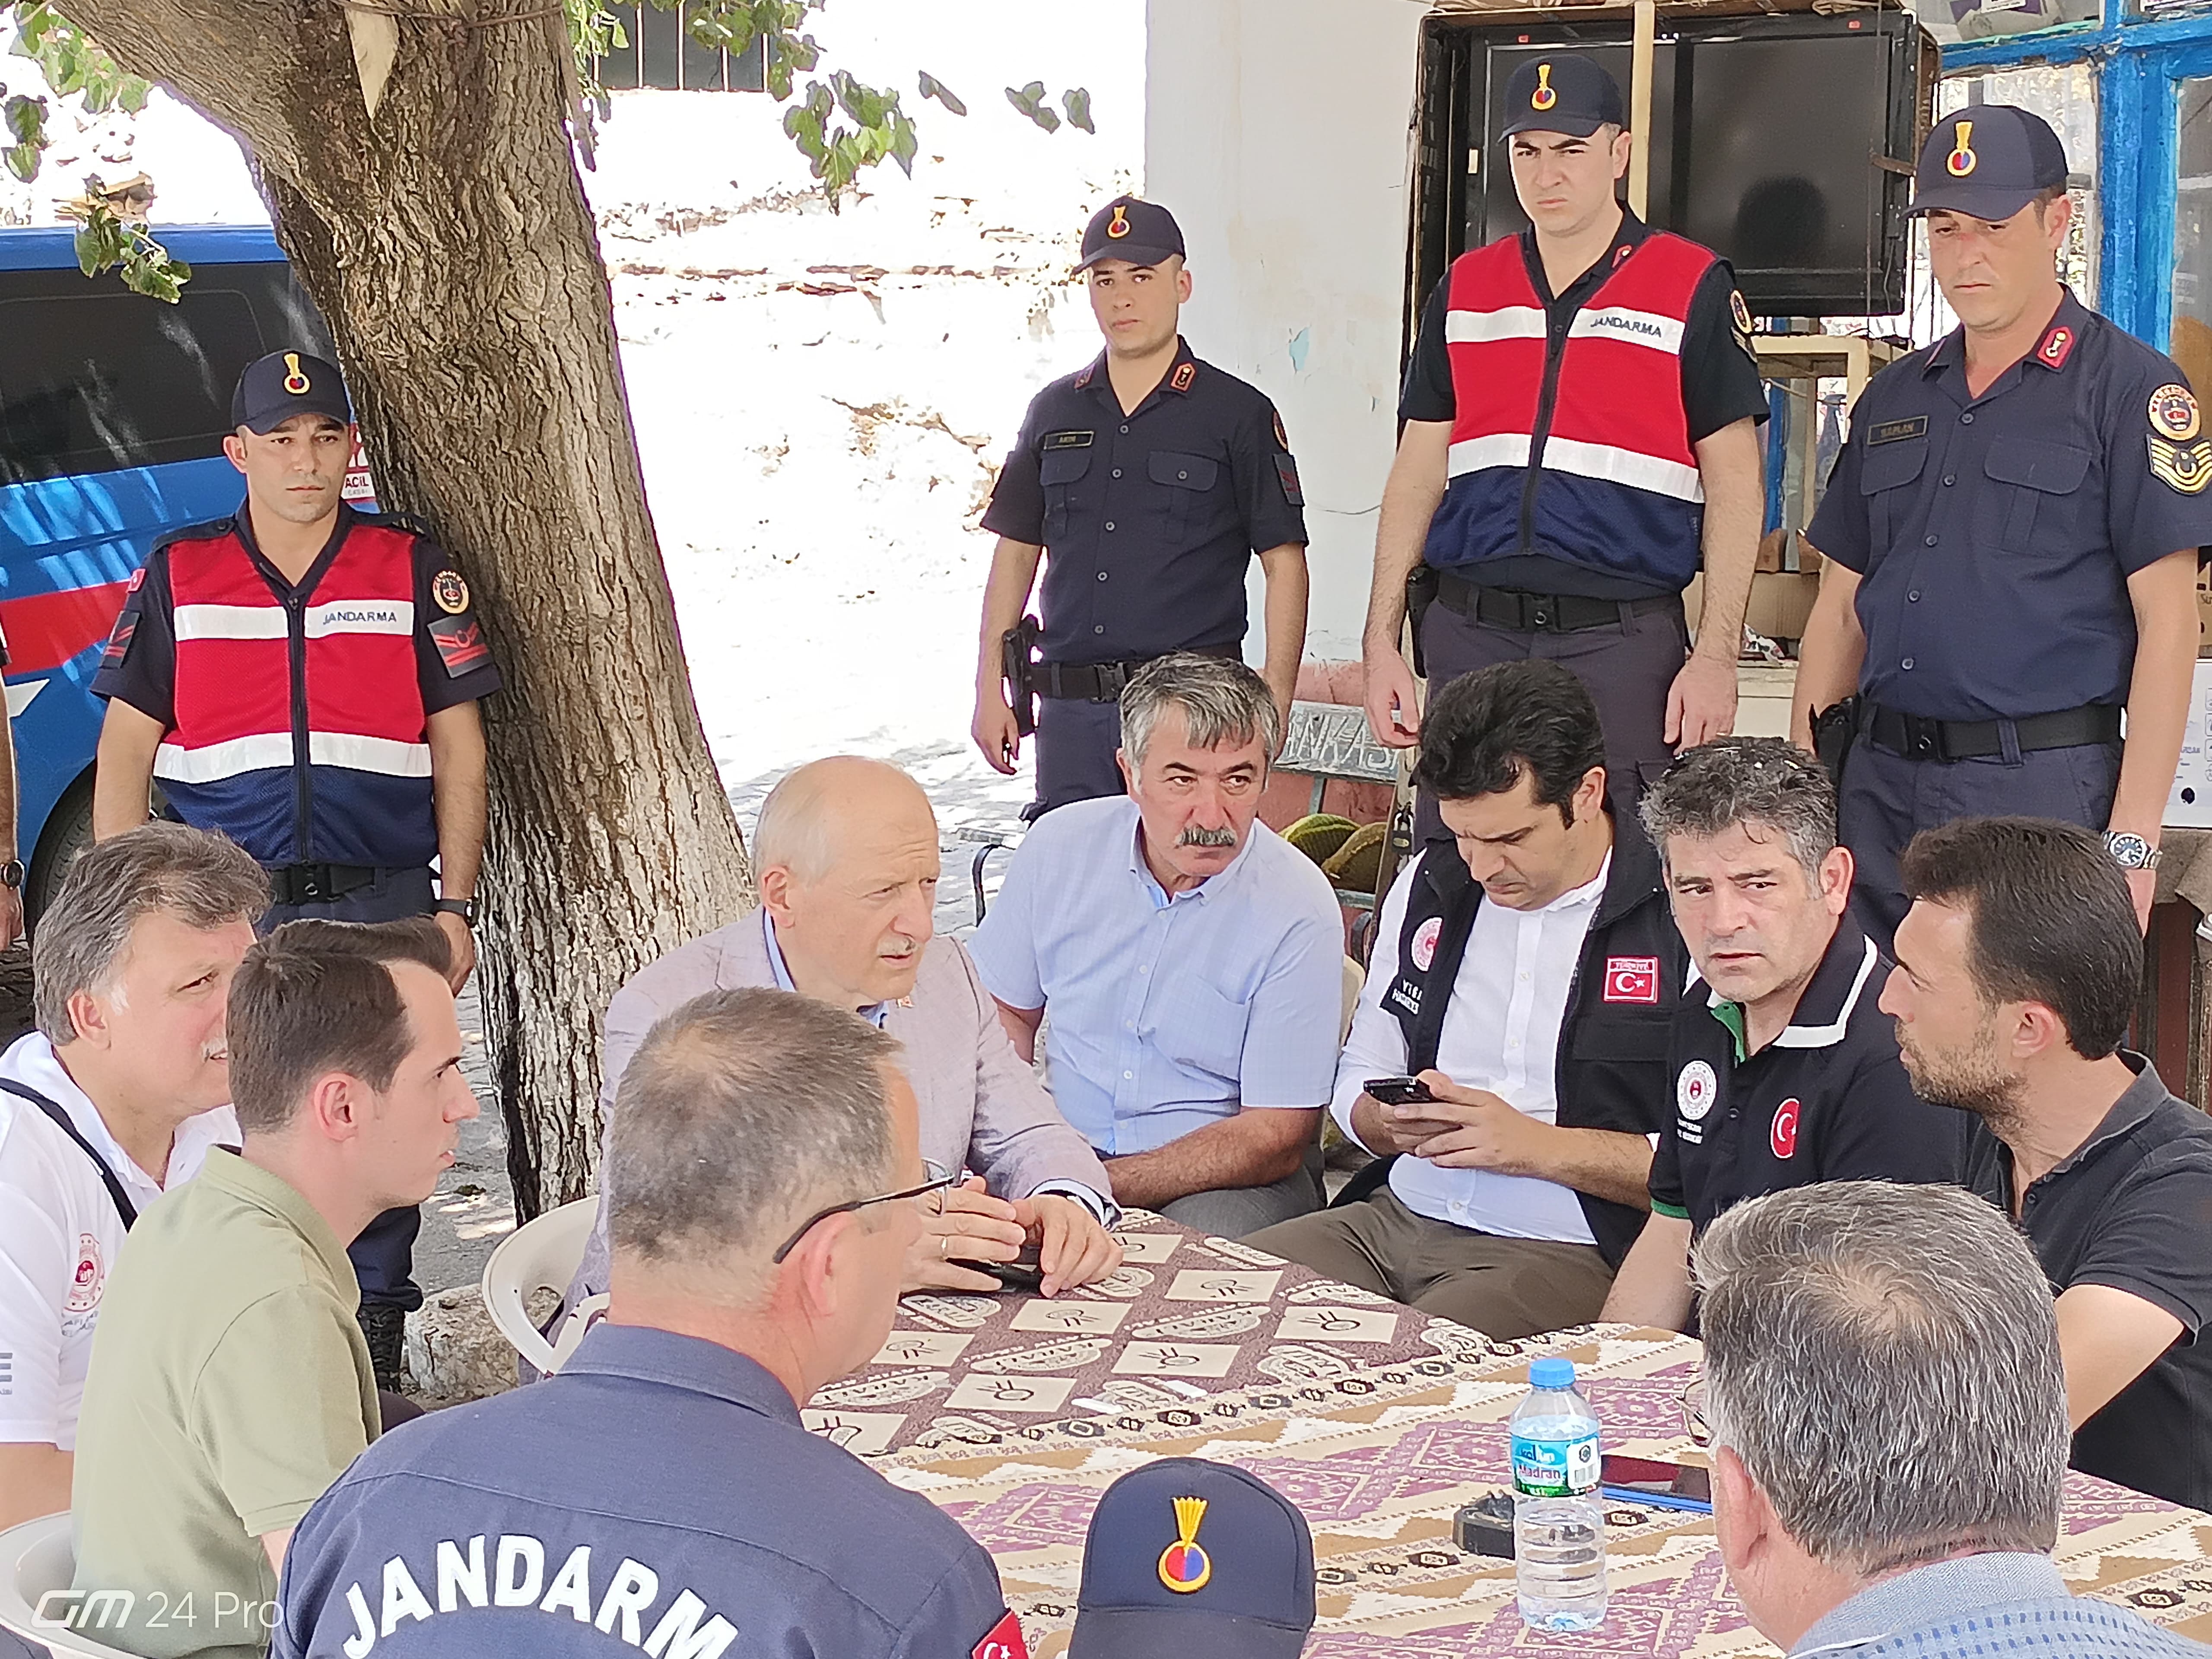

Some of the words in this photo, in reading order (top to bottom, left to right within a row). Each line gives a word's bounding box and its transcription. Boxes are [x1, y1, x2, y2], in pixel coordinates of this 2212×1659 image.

[1590, 316, 1662, 338] JANDARMA
[323, 611, 397, 625] JANDARMA
[1519, 1464, 1561, 1479] Madran
